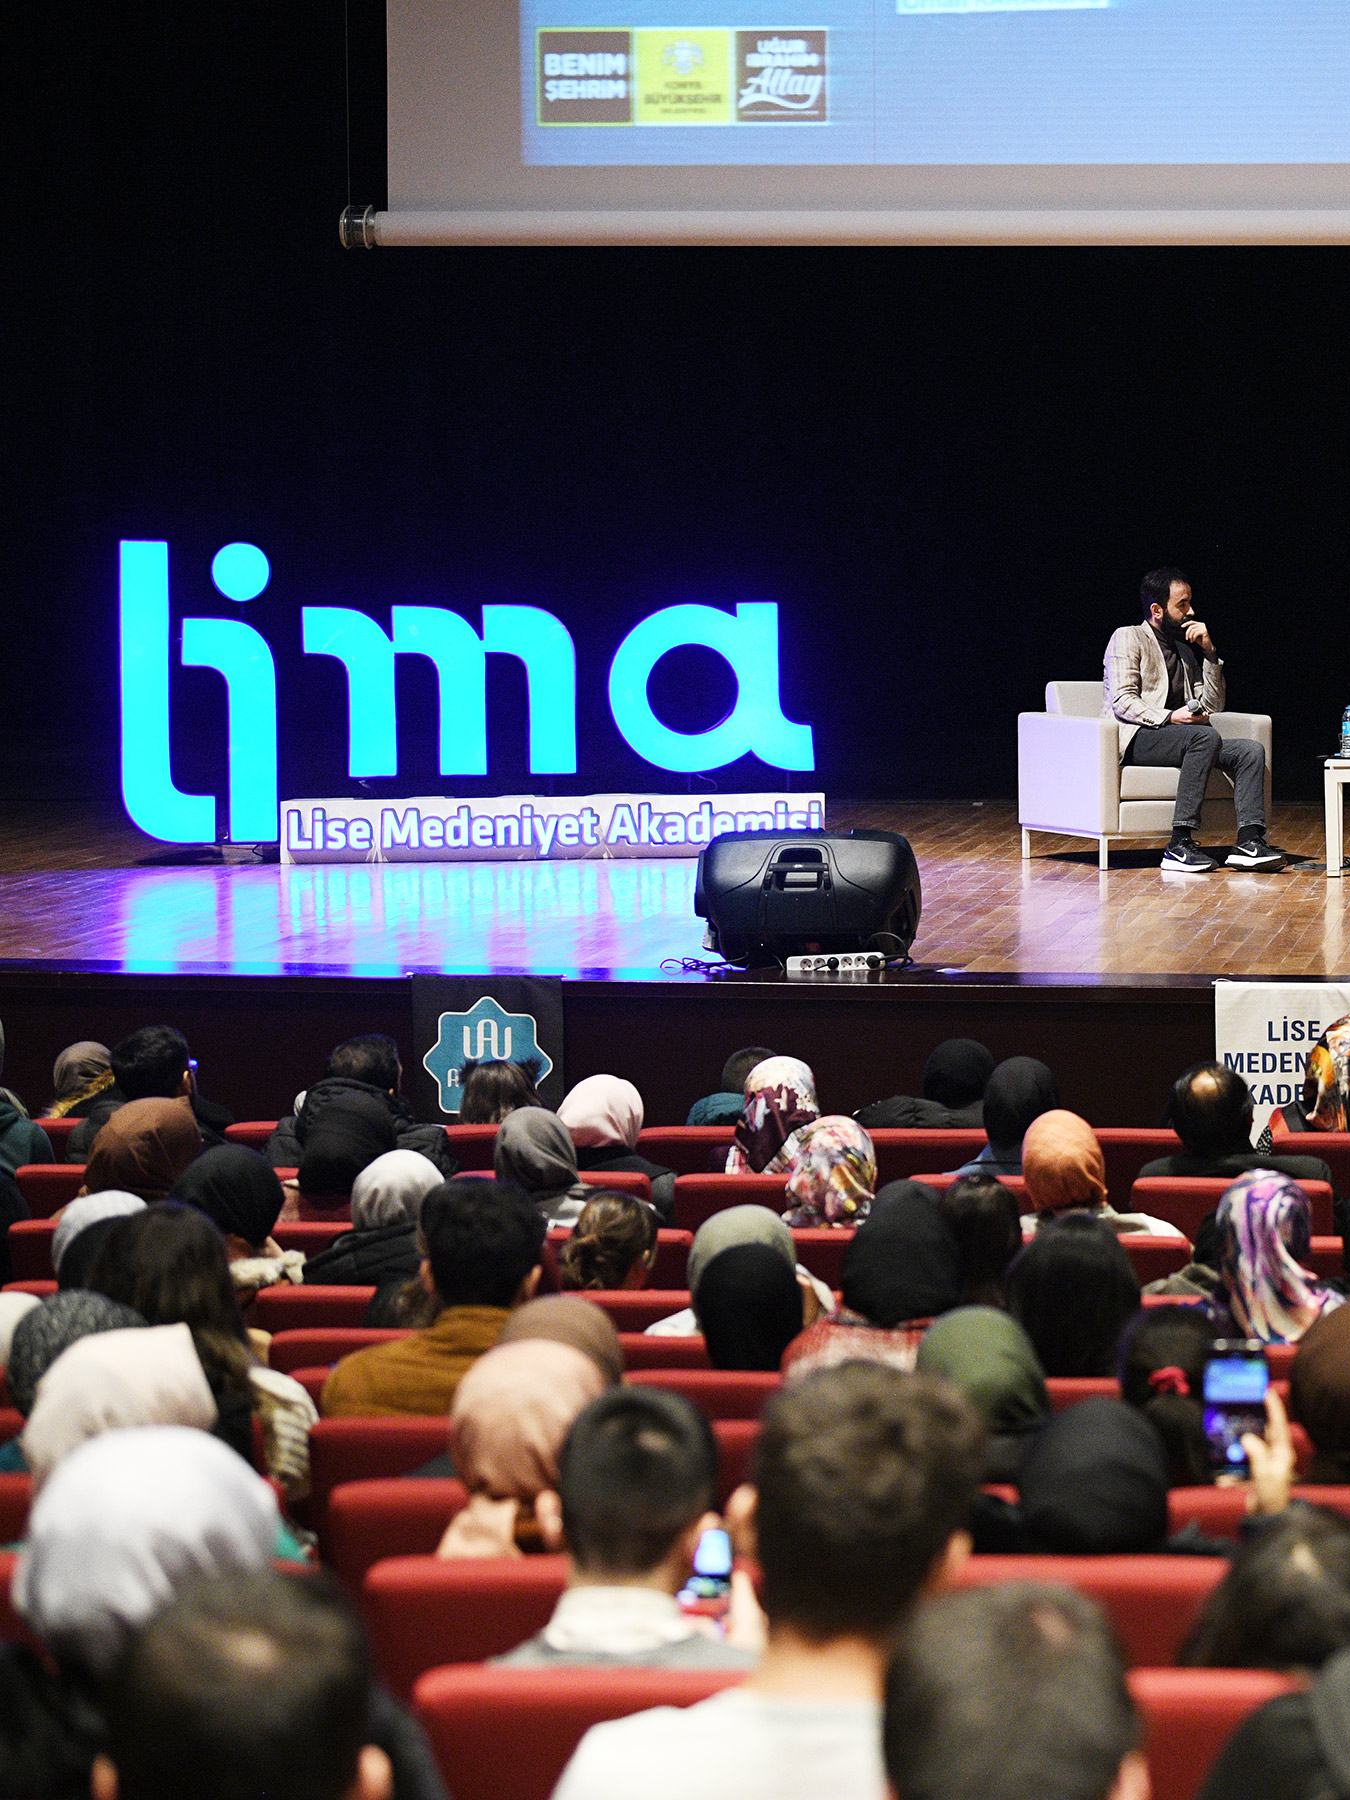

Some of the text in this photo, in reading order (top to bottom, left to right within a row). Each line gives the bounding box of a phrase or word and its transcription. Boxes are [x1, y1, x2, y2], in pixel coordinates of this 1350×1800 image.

[118, 540, 816, 844] lima
[287, 807, 373, 851] Lise
[381, 804, 600, 858] Medeniyet
[1268, 1015, 1320, 1042] LİSE
[1224, 1052, 1311, 1073] MEDEN
